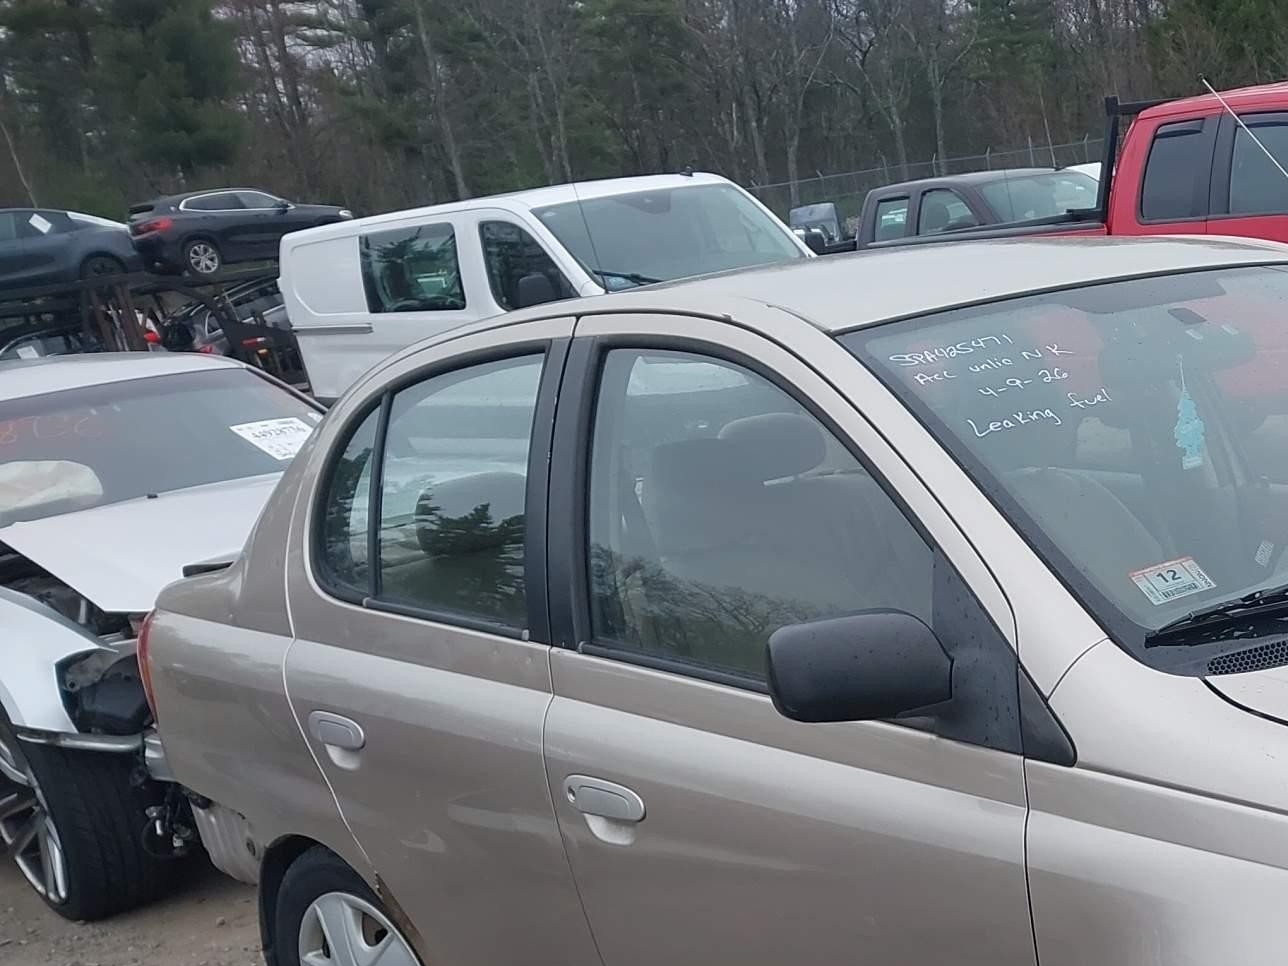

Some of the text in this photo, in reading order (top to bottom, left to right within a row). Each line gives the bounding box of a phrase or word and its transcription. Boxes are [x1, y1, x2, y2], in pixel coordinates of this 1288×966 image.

[1022, 348, 1042, 361] N
[1045, 343, 1073, 357] K
[1066, 388, 1114, 409] fuel
[1156, 569, 1182, 583] 12
